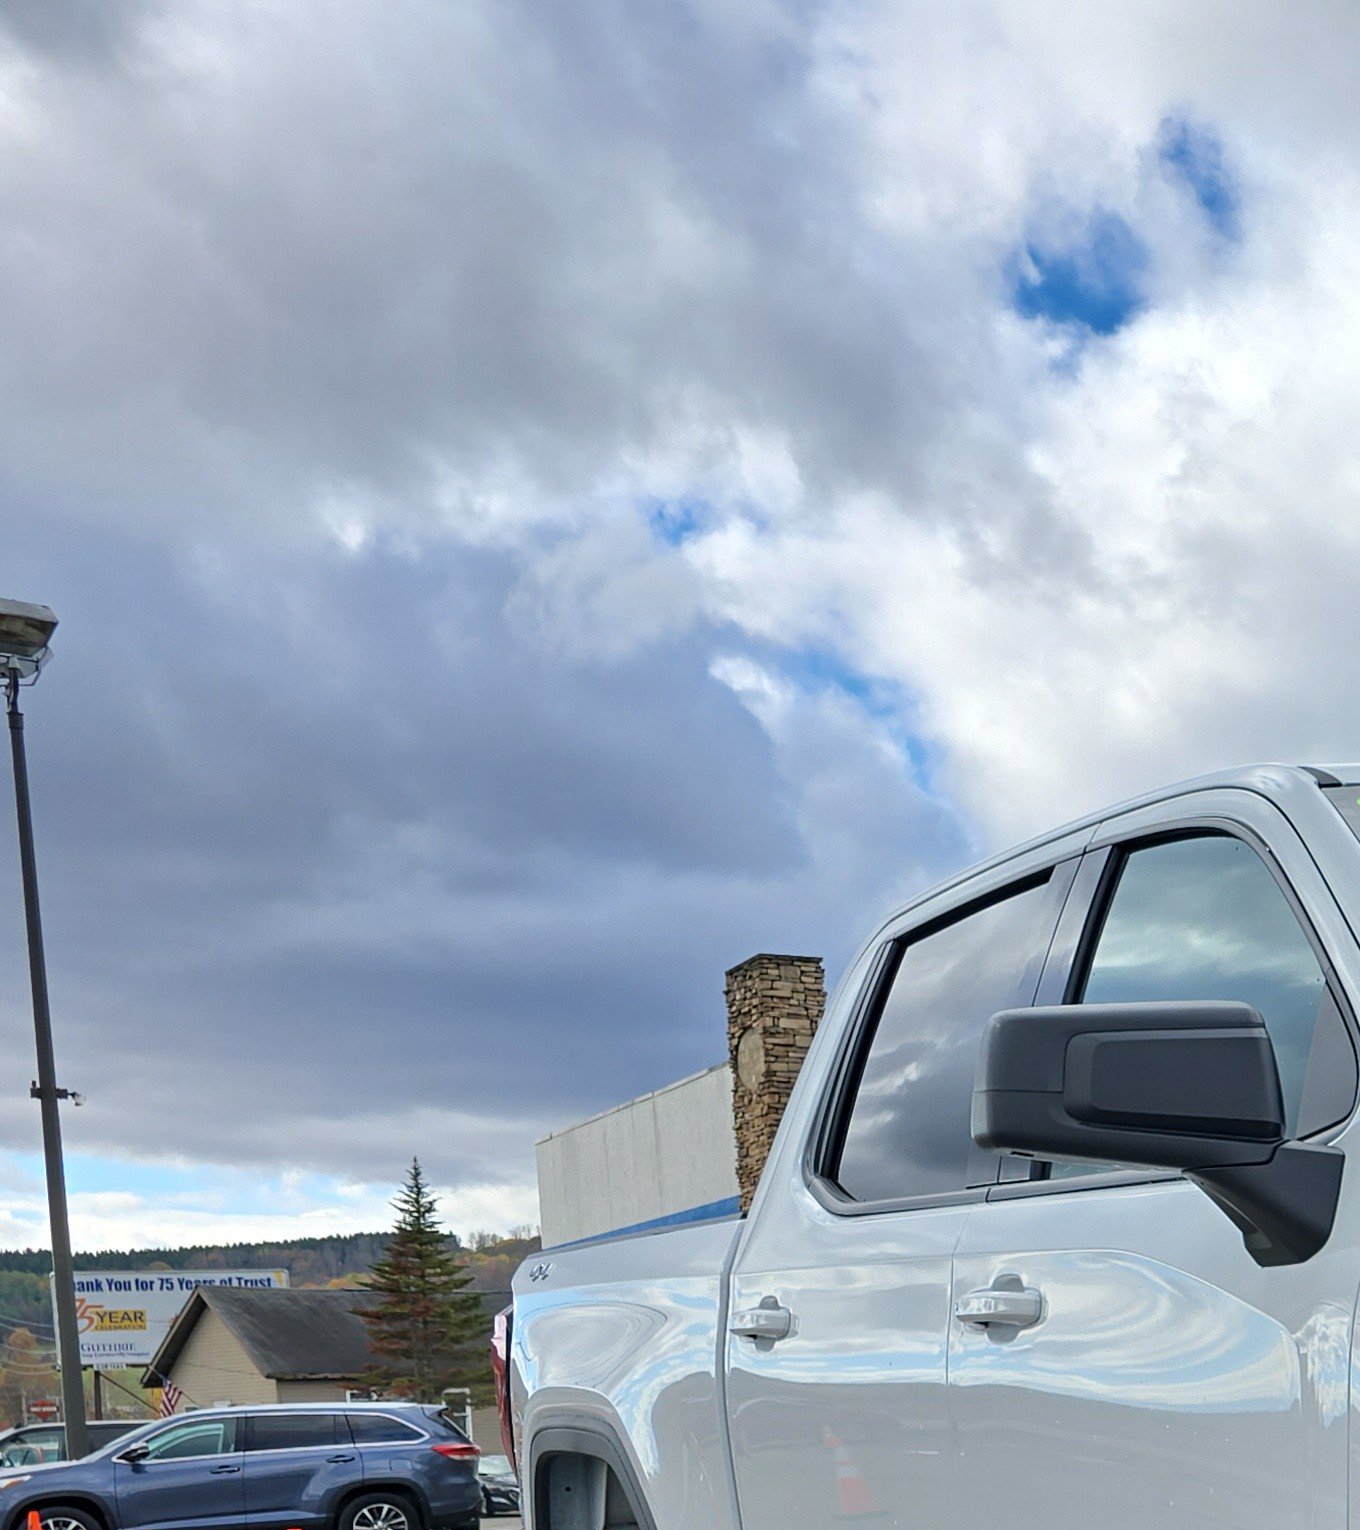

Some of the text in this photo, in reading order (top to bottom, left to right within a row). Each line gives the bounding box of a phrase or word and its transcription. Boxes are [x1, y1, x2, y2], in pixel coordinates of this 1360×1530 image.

[75, 1278, 103, 1292] ank
[106, 1278, 132, 1292] You
[135, 1278, 155, 1291] for
[158, 1277, 175, 1291] 75
[236, 1276, 272, 1288] Trust
[96, 1311, 144, 1324] YEAR
